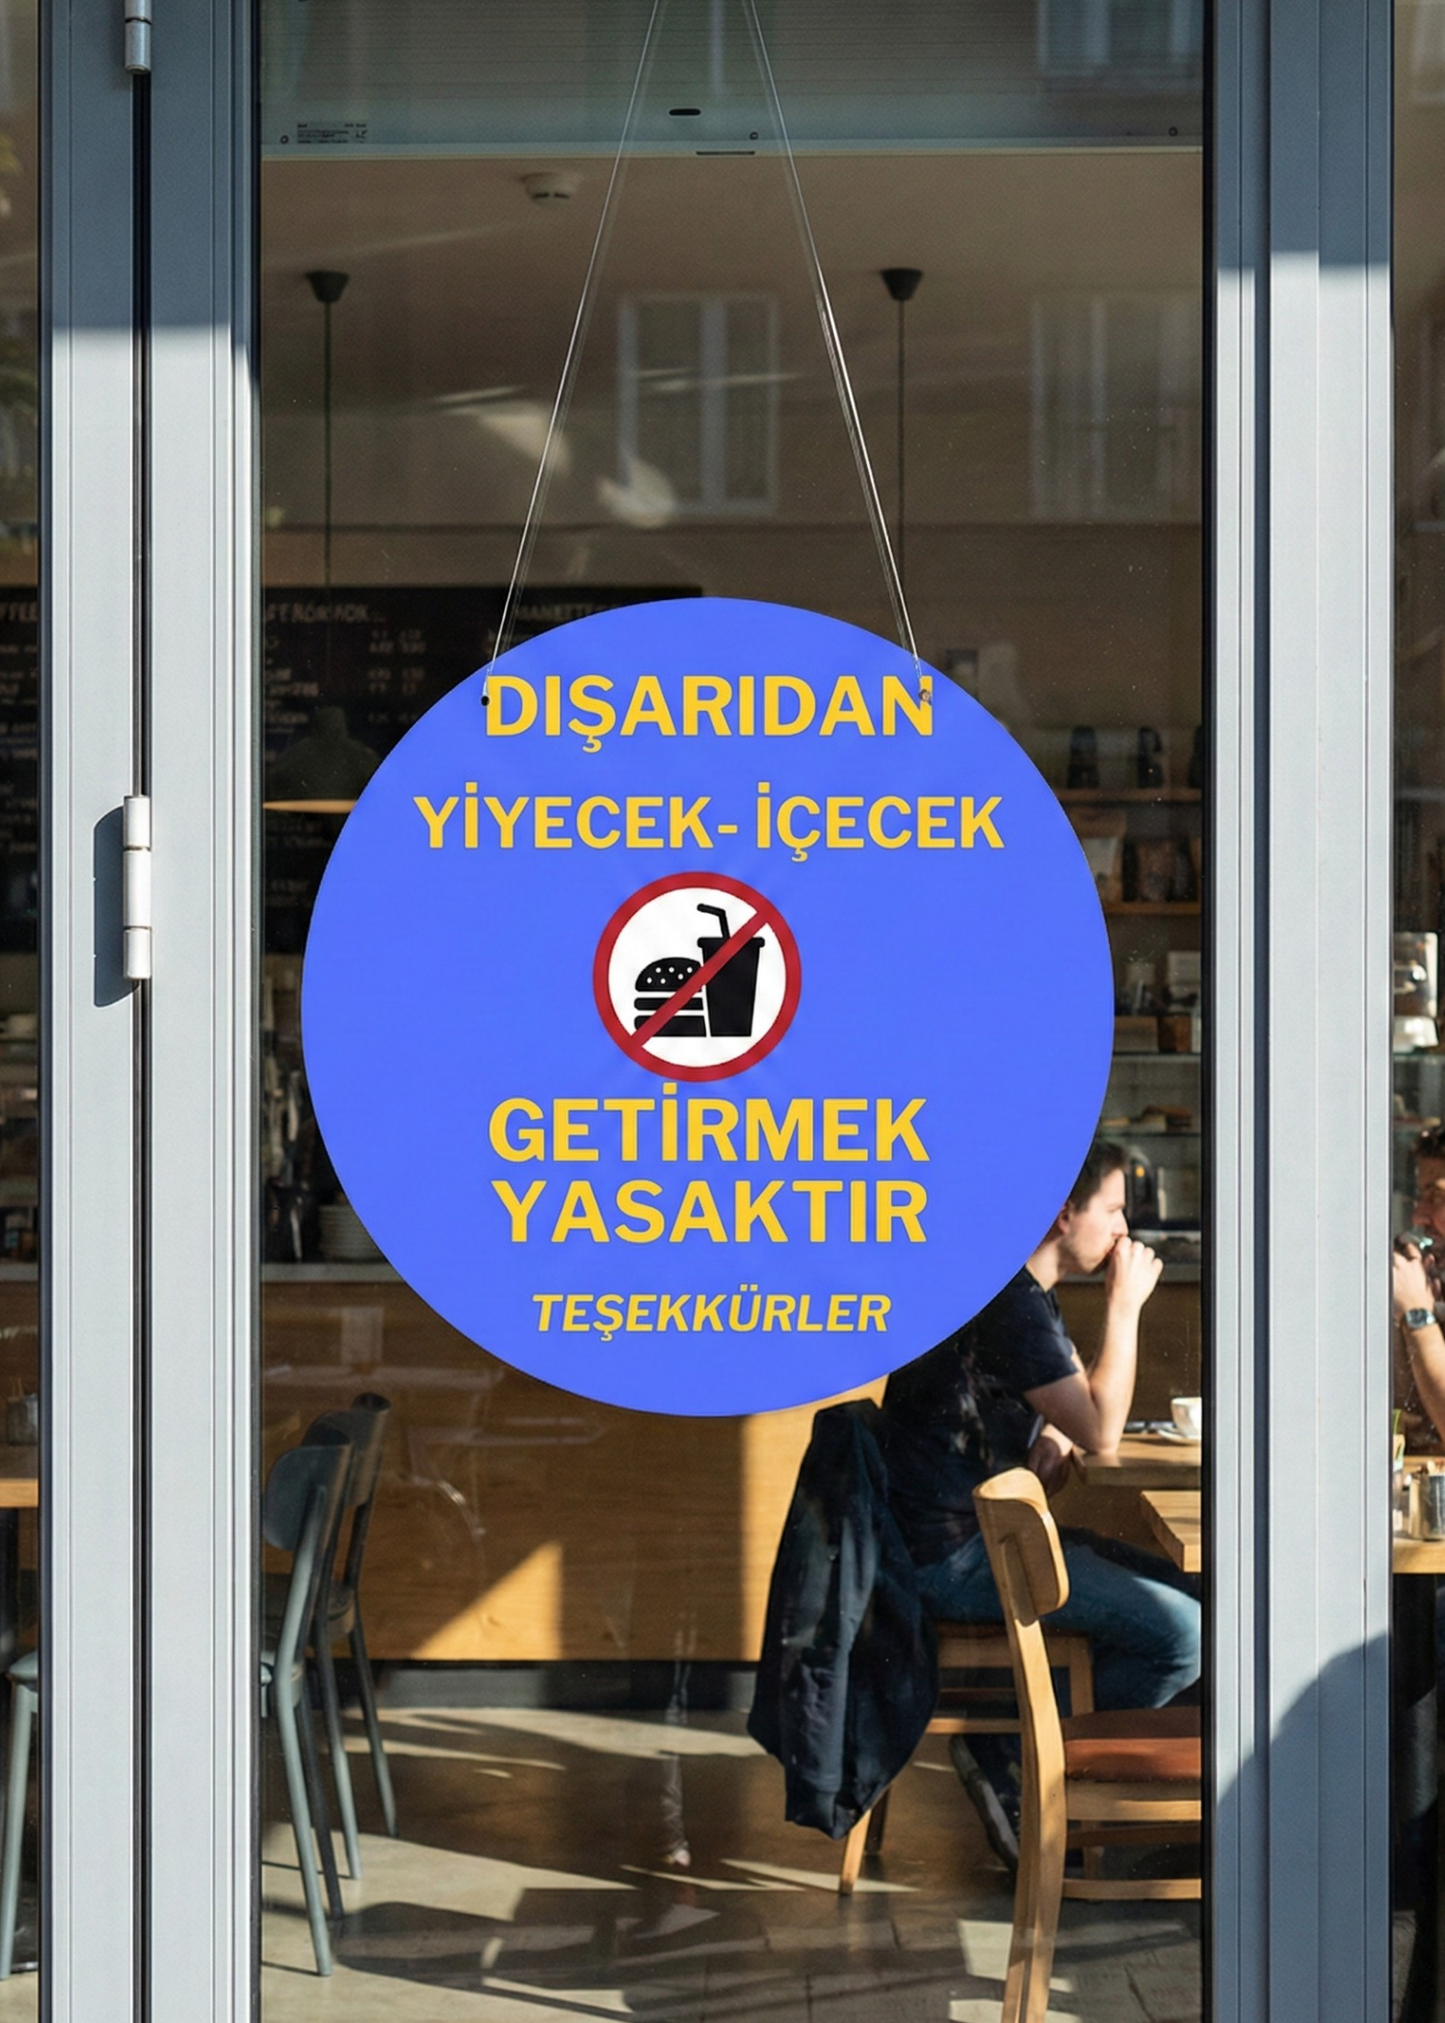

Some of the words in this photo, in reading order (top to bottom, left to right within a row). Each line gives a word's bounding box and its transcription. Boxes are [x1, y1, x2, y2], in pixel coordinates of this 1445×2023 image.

[486, 675, 933, 753] DIŞARIDAN
[756, 782, 1003, 862] İÇECEK
[489, 1082, 929, 1163] GETİRMEK
[492, 1180, 928, 1243] YASAKTIR
[532, 1284, 891, 1342] TEŞEKKÜRLER
